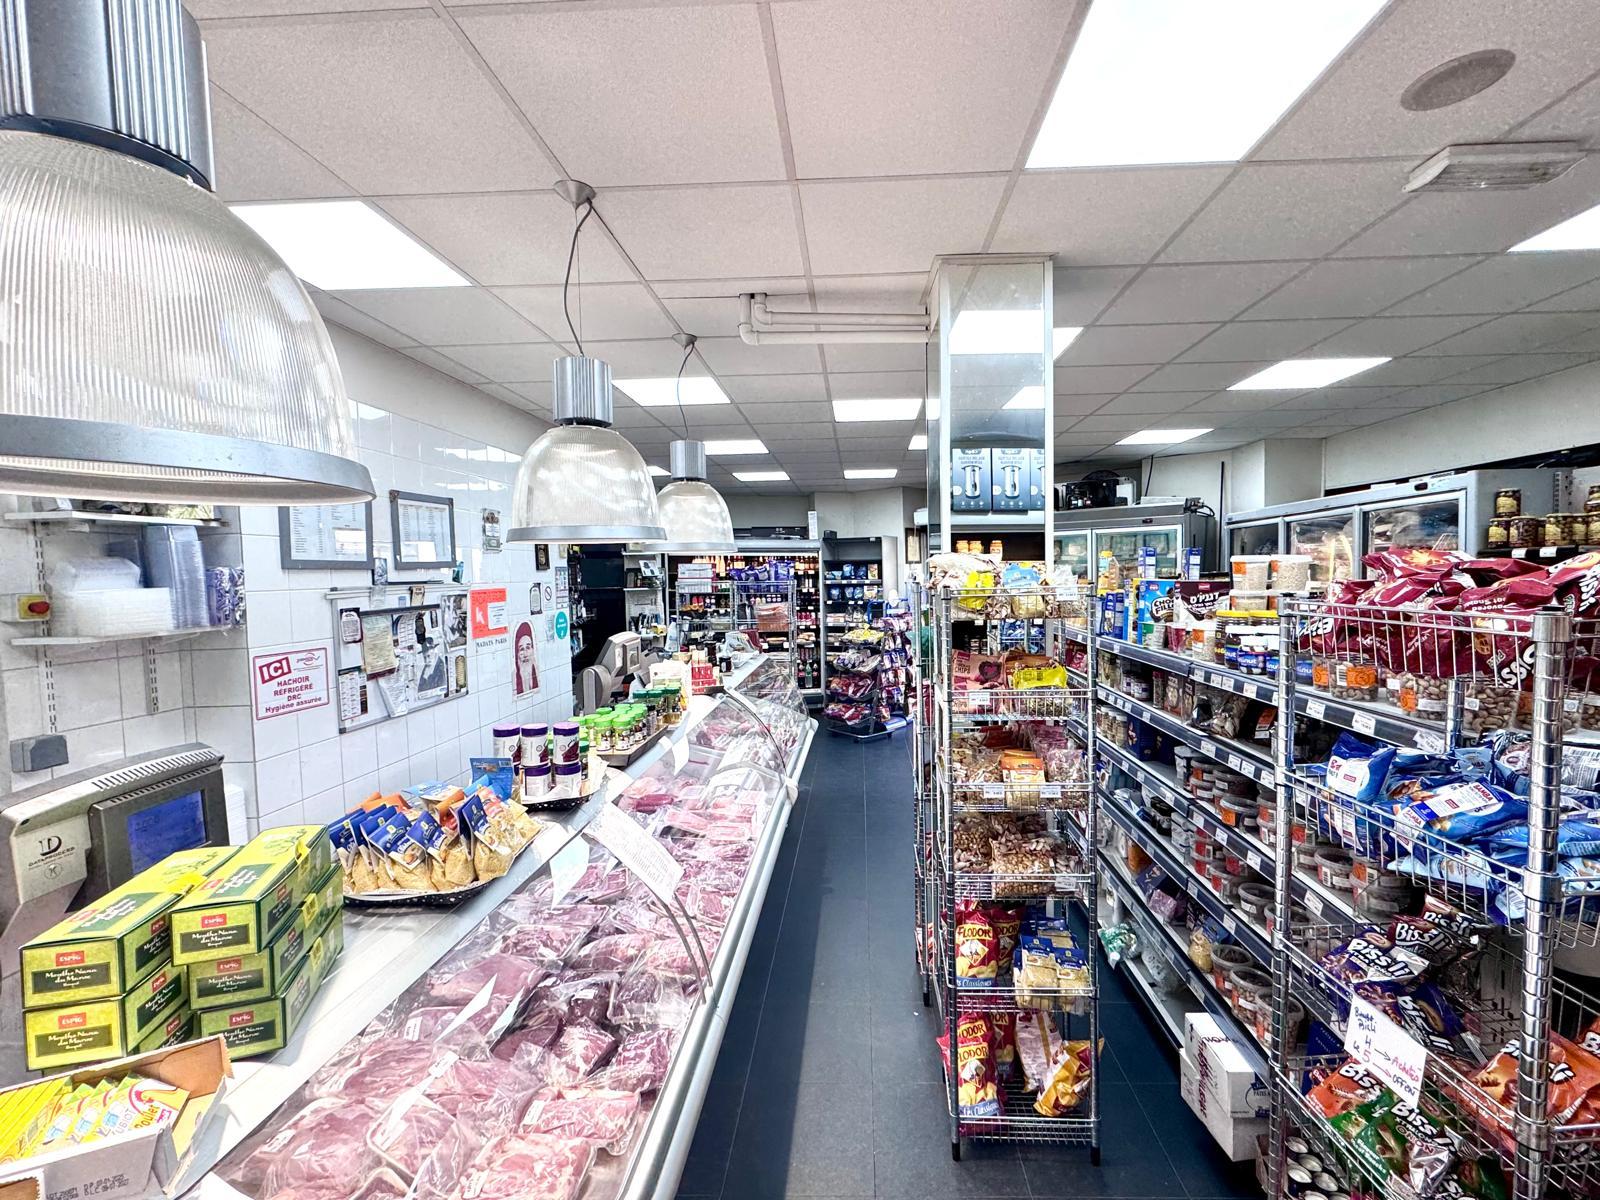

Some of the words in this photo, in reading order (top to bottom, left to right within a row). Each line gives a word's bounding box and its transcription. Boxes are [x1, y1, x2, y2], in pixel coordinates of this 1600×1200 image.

[261, 659, 290, 681] ICI
[1473, 783, 1494, 802] BAMBA
[957, 926, 992, 939] FLODOR
[1395, 922, 1450, 949] Bissli
[1347, 938, 1413, 978] Bissli
[961, 1023, 986, 1038] ODOR
[960, 1046, 989, 1062] LODOR
[1395, 1124, 1434, 1154] ONION
